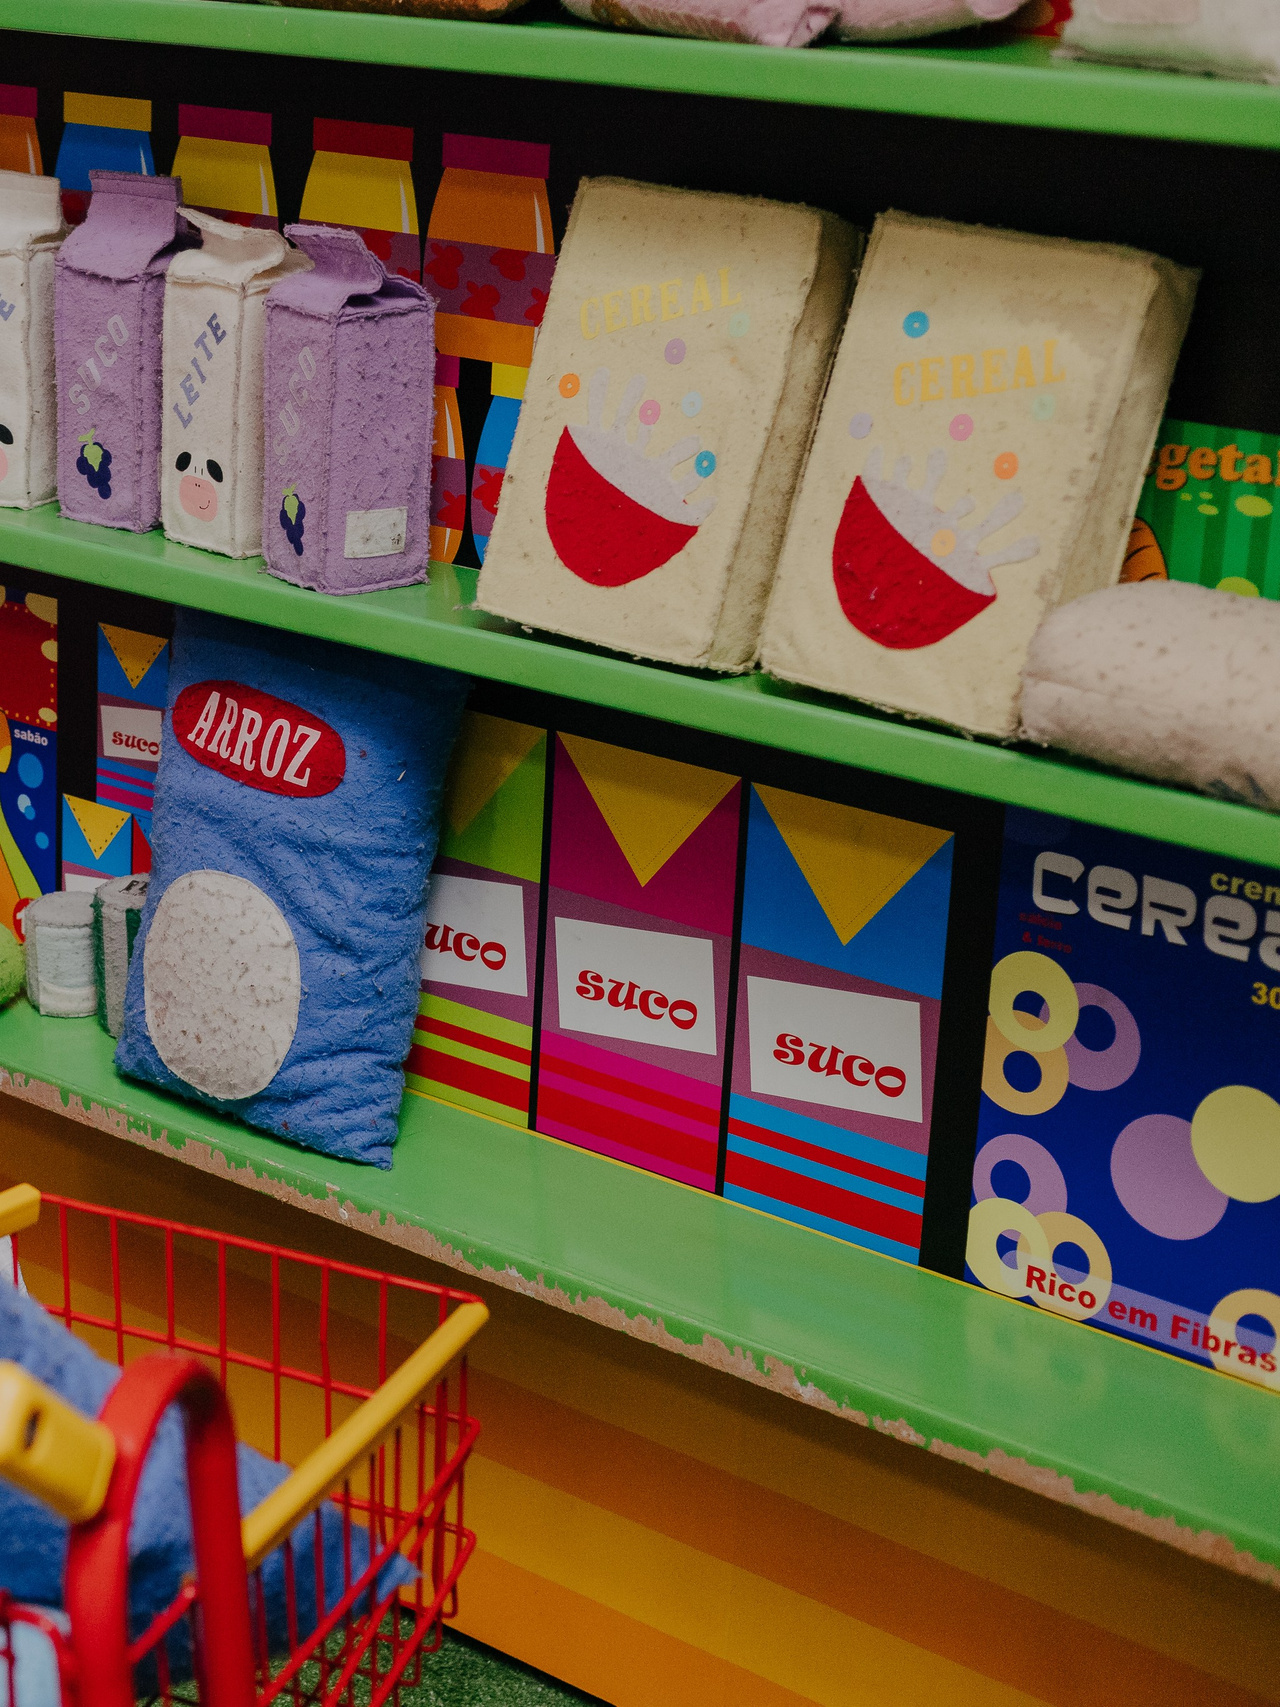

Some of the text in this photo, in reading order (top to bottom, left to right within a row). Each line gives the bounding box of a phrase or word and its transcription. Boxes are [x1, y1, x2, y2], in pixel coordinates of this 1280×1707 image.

[579, 266, 743, 340] CEREAL
[69, 314, 129, 415] SUCO
[173, 312, 227, 429] LEITE
[892, 340, 1066, 406] CEREAL
[14, 728, 48, 747] sabão
[112, 731, 160, 756] suco
[187, 691, 322, 788] ARROZ
[575, 969, 698, 1030] suco
[773, 1032, 907, 1098] suco
[1025, 1264, 1278, 1374] Rico em Fibras
